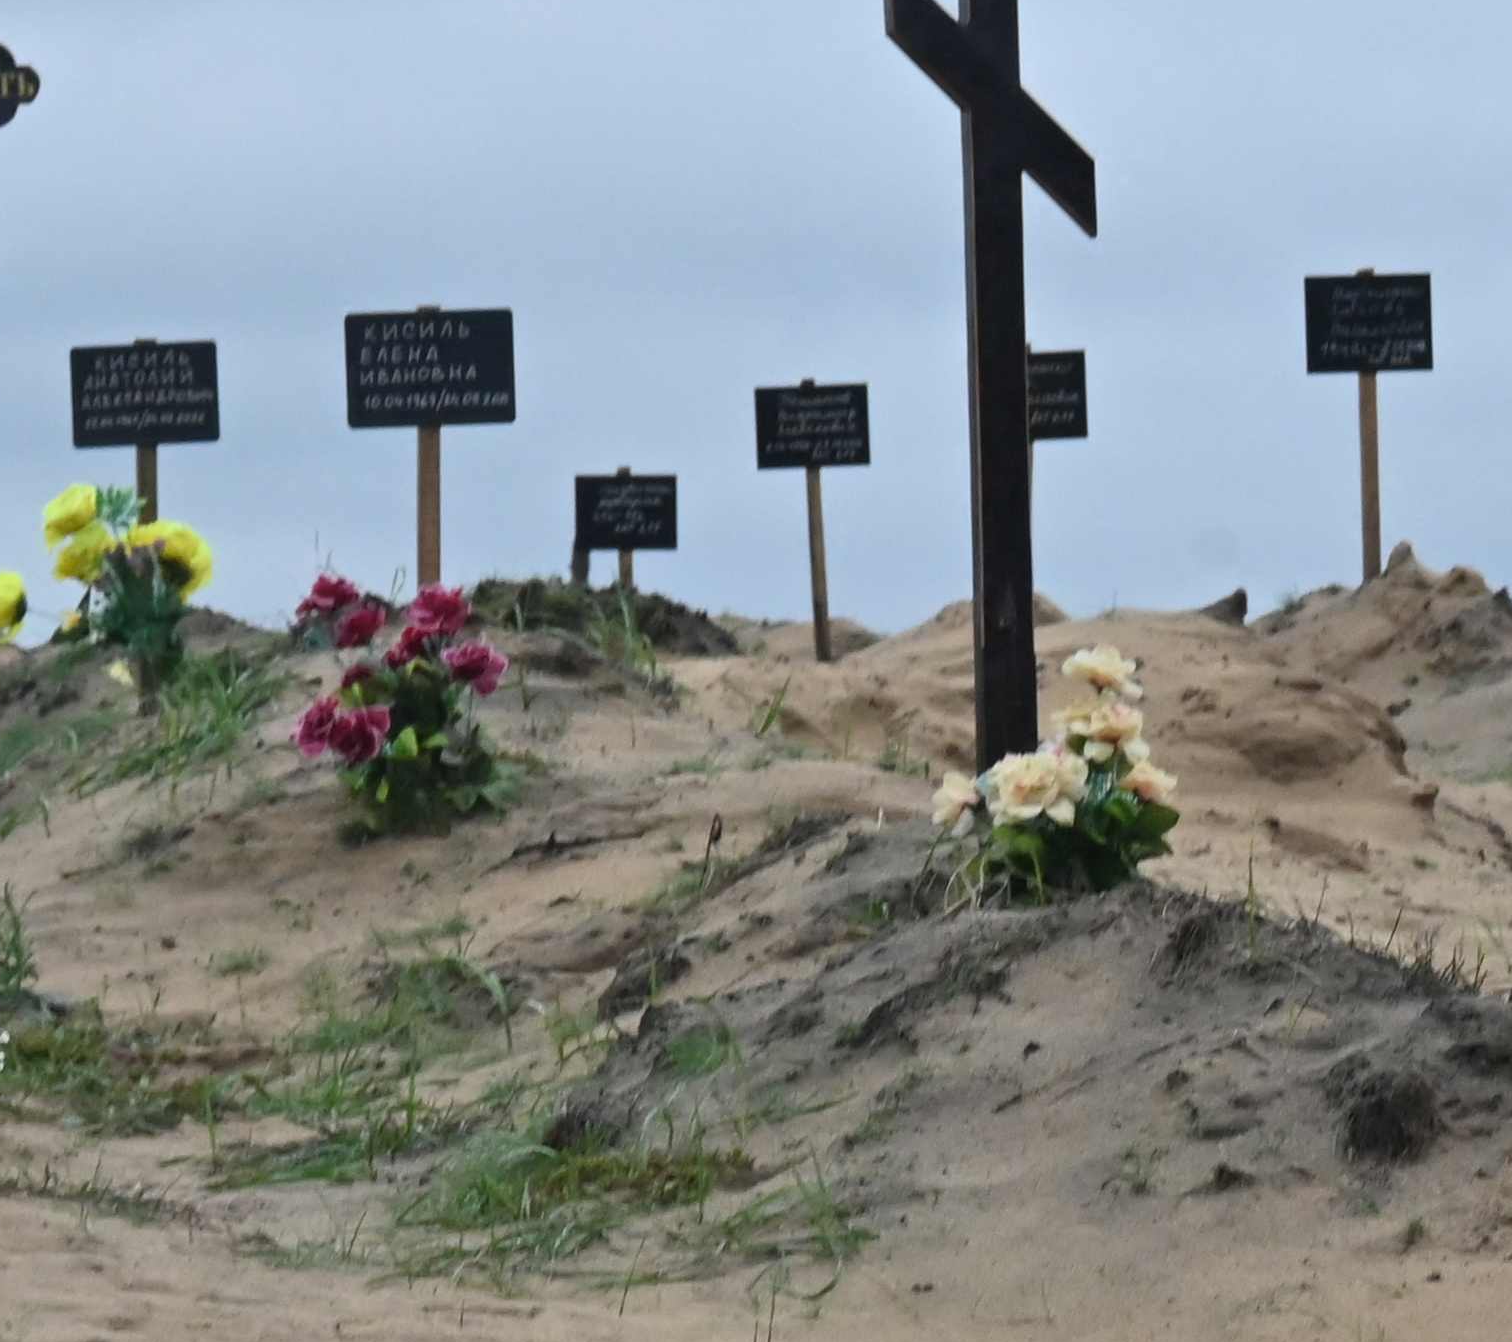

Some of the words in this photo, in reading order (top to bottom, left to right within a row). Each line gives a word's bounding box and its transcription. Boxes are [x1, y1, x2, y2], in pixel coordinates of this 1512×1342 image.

[363, 319, 470, 341] КИСИЛЬ
[359, 343, 439, 366] ЕЛЕНА
[359, 364, 478, 387] ИВАНОВНА
